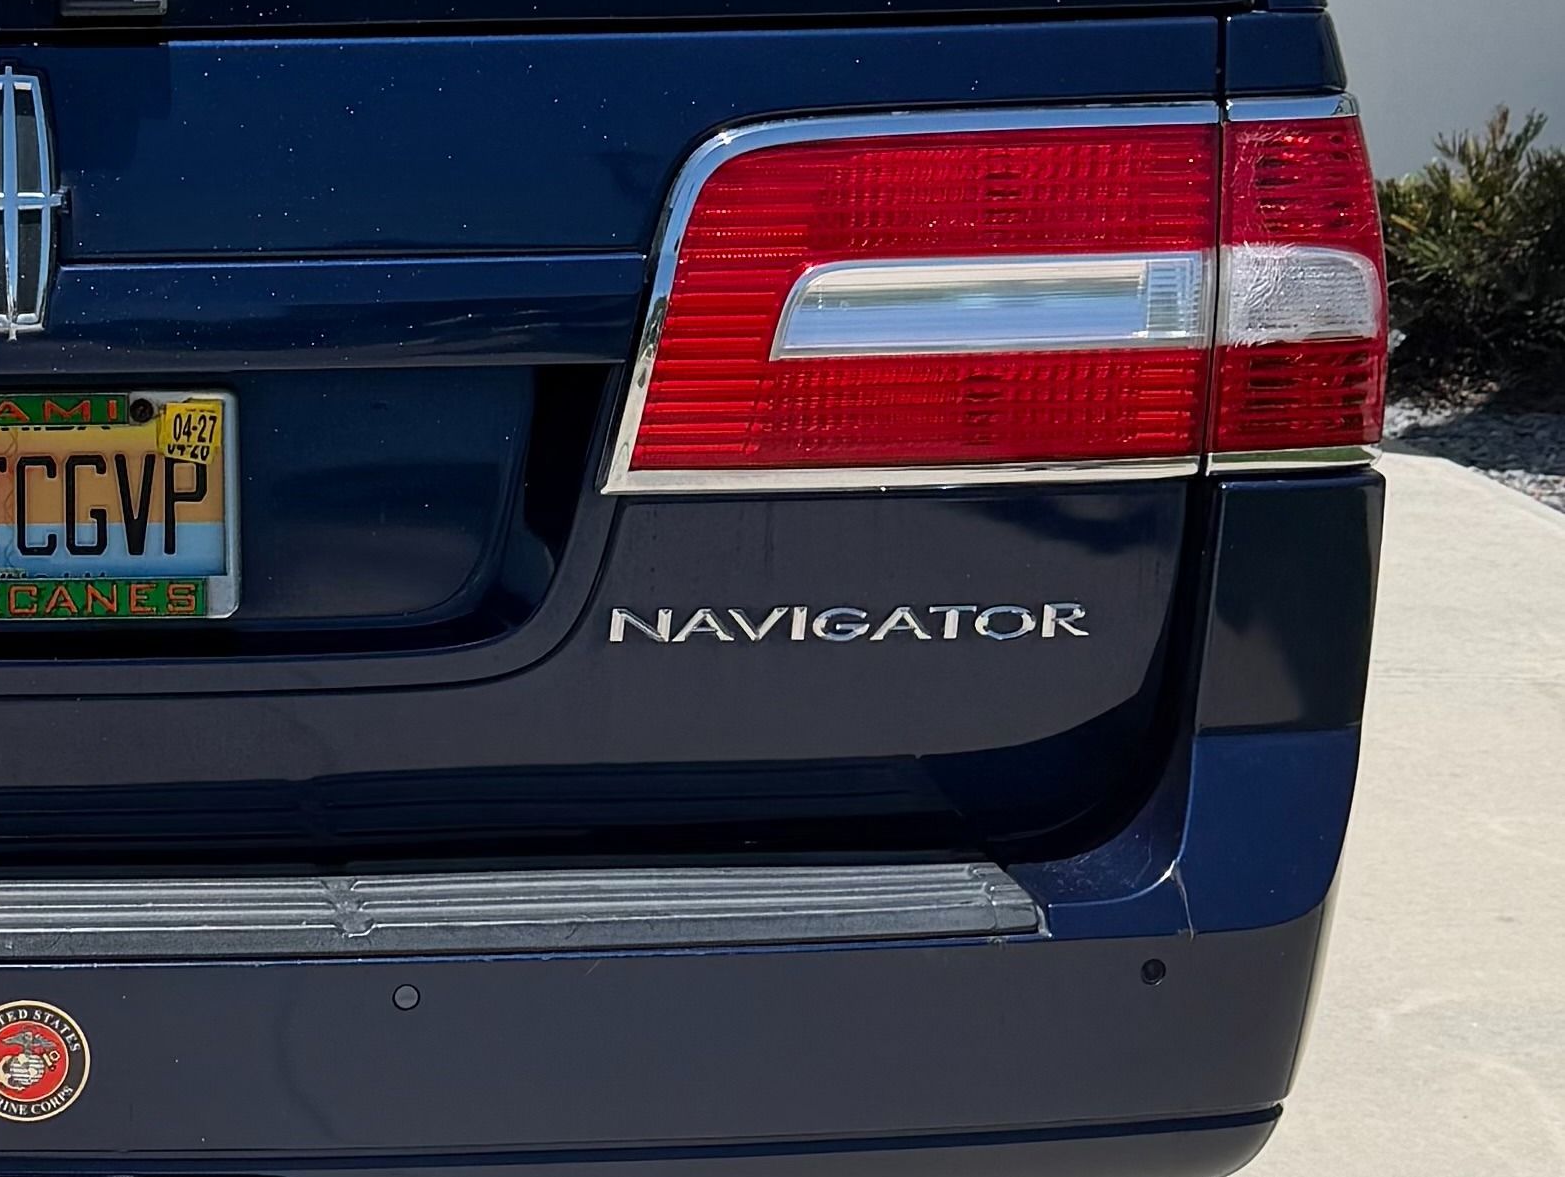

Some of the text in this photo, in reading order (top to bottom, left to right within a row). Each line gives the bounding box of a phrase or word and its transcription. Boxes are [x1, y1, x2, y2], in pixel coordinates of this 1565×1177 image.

[609, 603, 1090, 643] NAVIGATOR
[33, 1008, 81, 1052] STATES
[31, 1085, 74, 1115] CORPS
